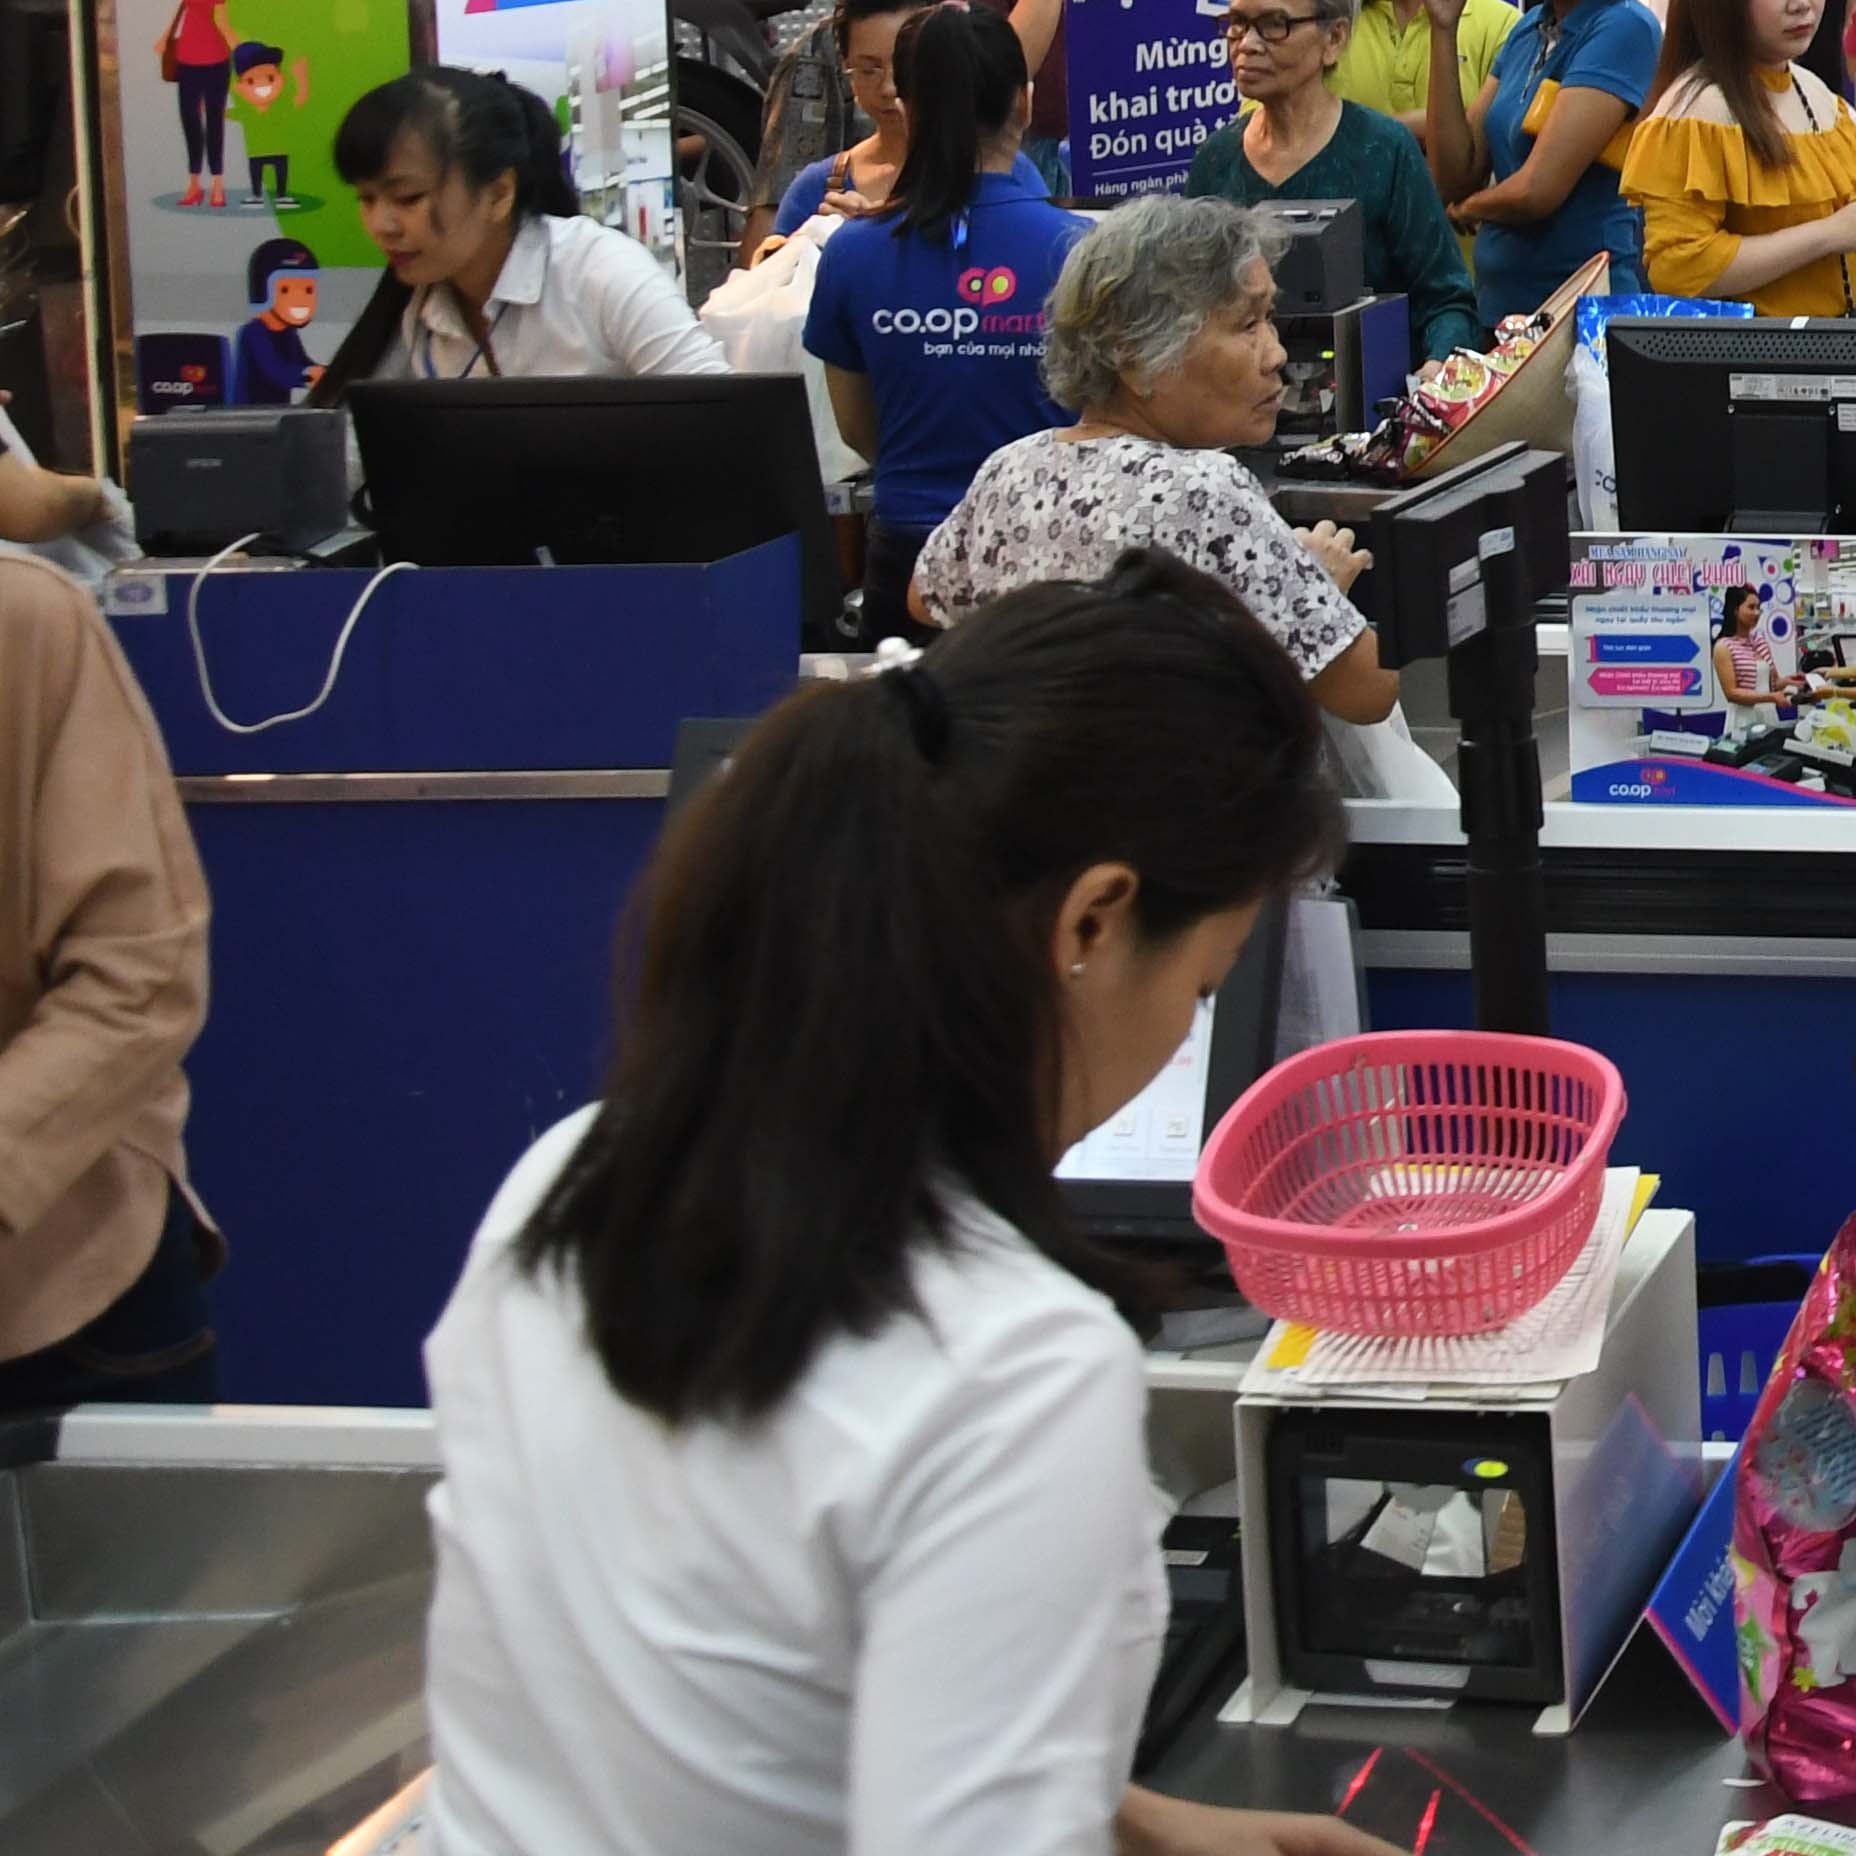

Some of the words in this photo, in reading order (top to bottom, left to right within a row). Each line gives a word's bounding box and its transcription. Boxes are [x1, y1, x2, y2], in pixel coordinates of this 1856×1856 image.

[1135, 37, 1229, 73] Mừng
[1089, 86, 1158, 125] khai
[1089, 132, 1147, 160] Đón
[1155, 117, 1208, 155] quà
[872, 307, 979, 341] co.op
[923, 342, 954, 358] bạn
[957, 341, 985, 356] của
[988, 342, 1015, 360] mọi
[1683, 668, 1702, 696] 2
[1609, 784, 1651, 799] co.op
